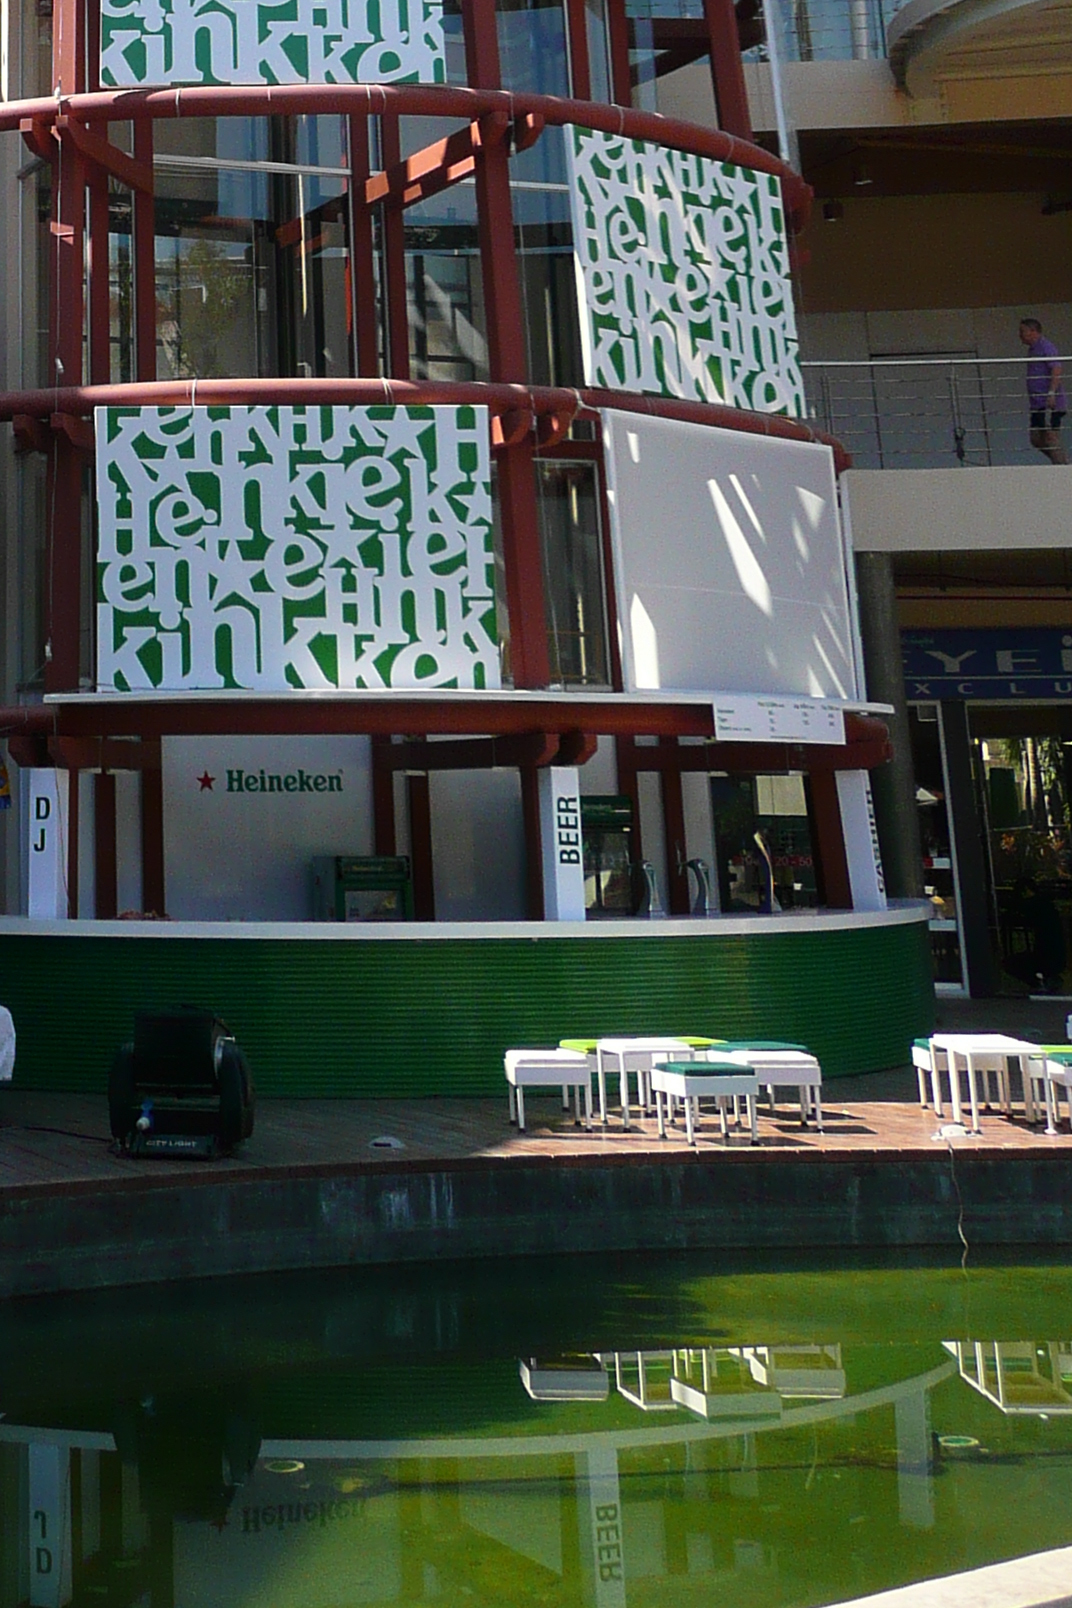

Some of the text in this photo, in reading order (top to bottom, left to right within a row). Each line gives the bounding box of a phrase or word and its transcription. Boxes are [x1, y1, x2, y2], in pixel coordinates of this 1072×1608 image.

[903, 634, 1072, 674] YEi
[226, 768, 344, 793] Heineken
[557, 796, 580, 864] BEER
